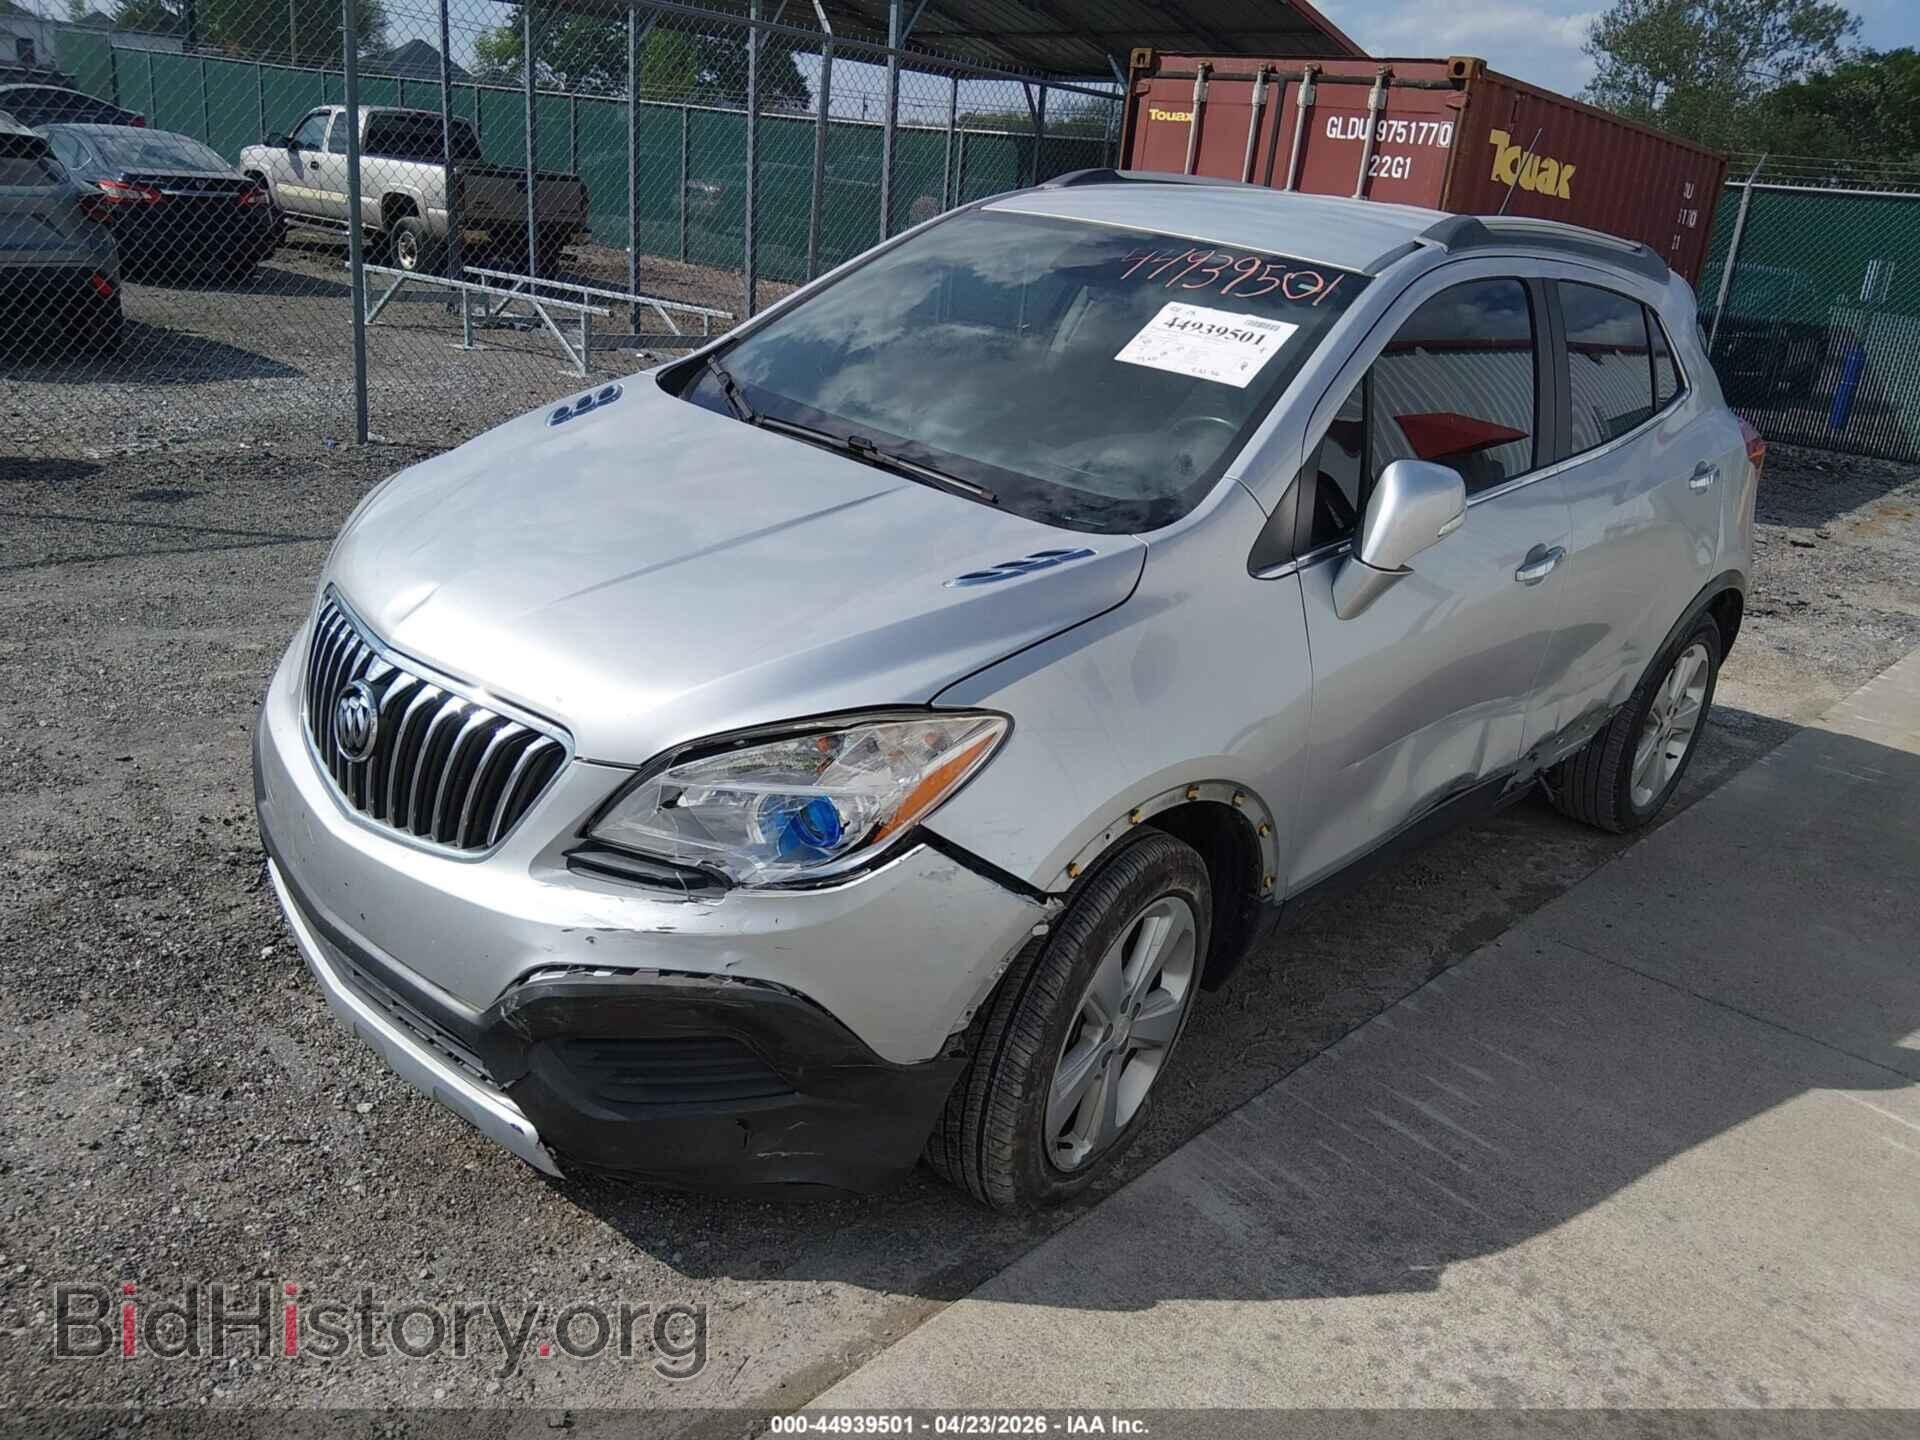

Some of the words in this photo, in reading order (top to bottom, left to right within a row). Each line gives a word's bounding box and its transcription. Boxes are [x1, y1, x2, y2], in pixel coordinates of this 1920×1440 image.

[1326, 116, 1370, 141] GLDU
[1375, 120, 1454, 148] 9751770
[1368, 155, 1412, 180] 22G1
[1489, 128, 1577, 200] Touax
[1163, 316, 1267, 346] 44939501
